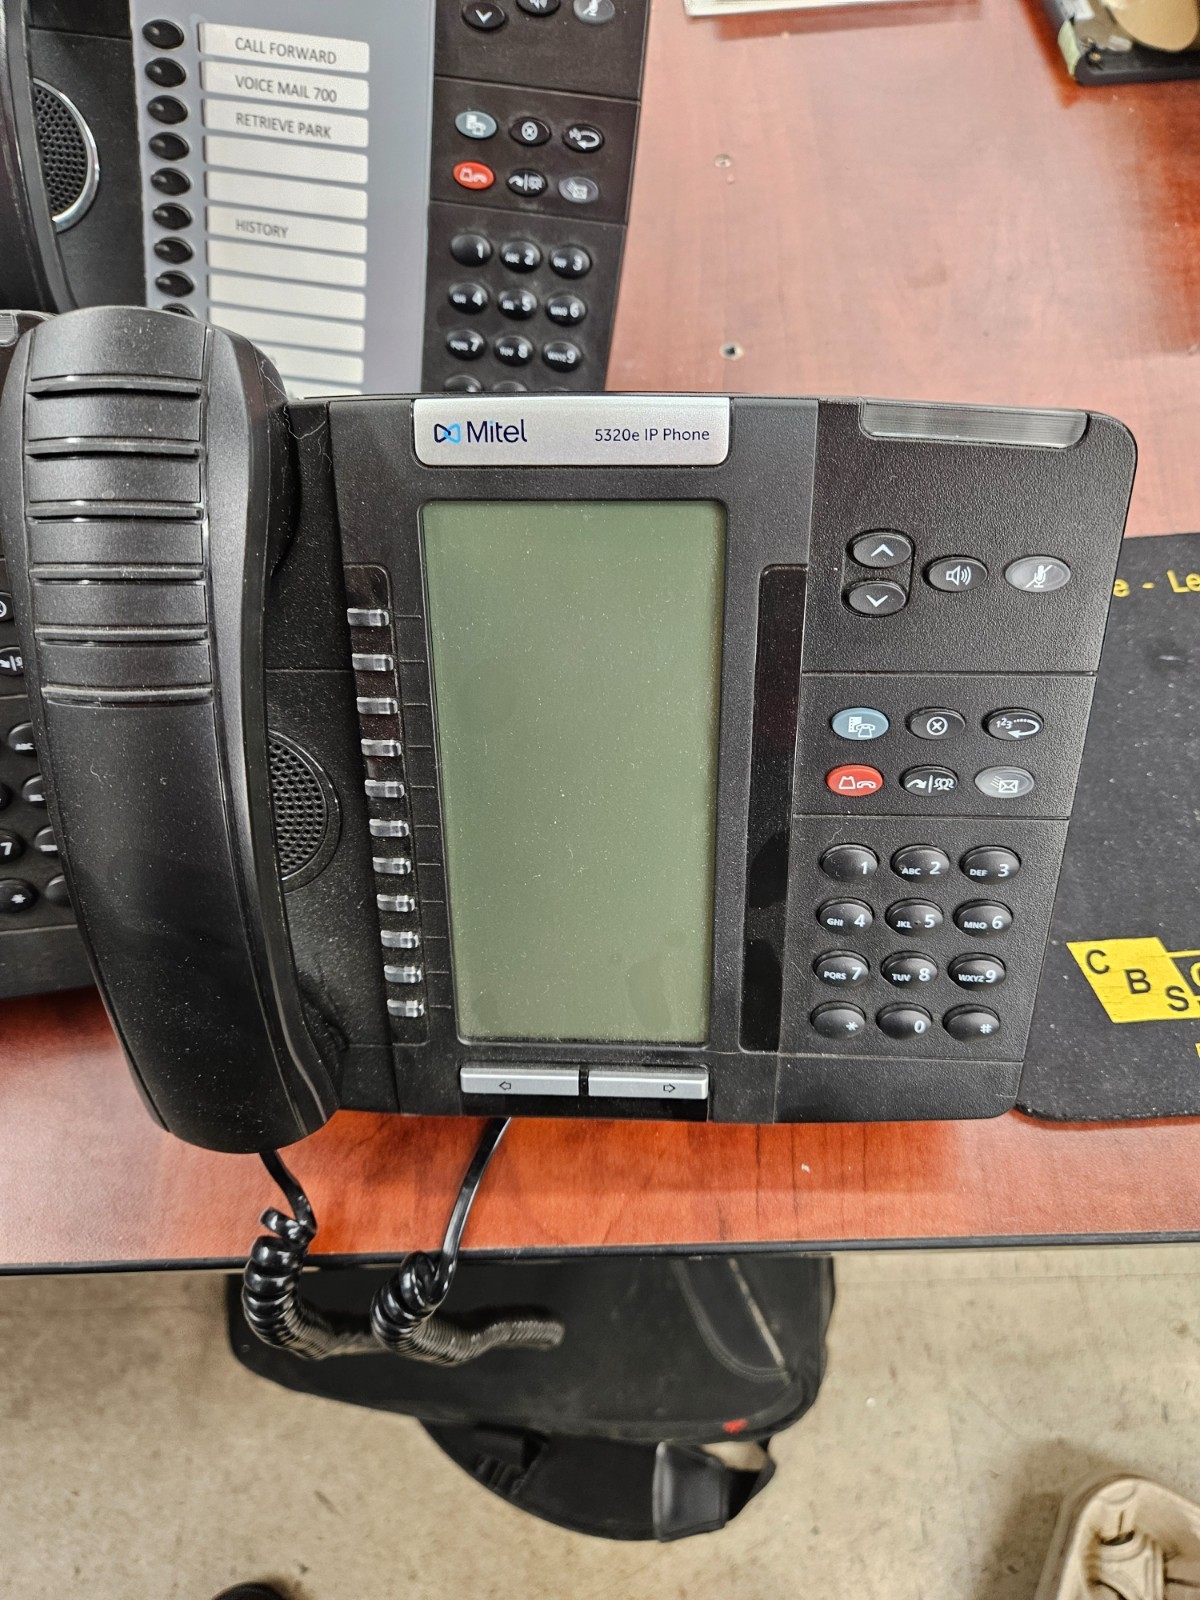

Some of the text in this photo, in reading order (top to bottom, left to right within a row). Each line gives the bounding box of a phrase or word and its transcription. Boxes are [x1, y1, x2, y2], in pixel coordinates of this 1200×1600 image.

[235, 37, 337, 65] CALL FORWARD
[235, 75, 338, 103] VOICE MAIL 700
[235, 112, 332, 139] RETRIEVE PARK
[235, 219, 289, 238] HISTORY
[524, 249, 534, 266] 2
[572, 255, 583, 271] 3
[569, 302, 580, 318] 6
[470, 338, 480, 352] 7
[566, 349, 576, 364] 9
[466, 418, 528, 443] Mitel
[594, 428, 711, 442] 5320e IP Phone
[861, 861, 868, 875] 1
[901, 861, 941, 875] ABC 2
[969, 863, 1010, 877] DEF 3
[826, 913, 866, 928] GHI 4
[896, 914, 936, 929] JKL 5
[963, 915, 1004, 930] MNO 6
[823, 966, 863, 981] PQRS 7
[891, 967, 931, 982] TUV 8
[958, 969, 998, 984] WXYZ 9
[913, 1020, 926, 1034] 0
